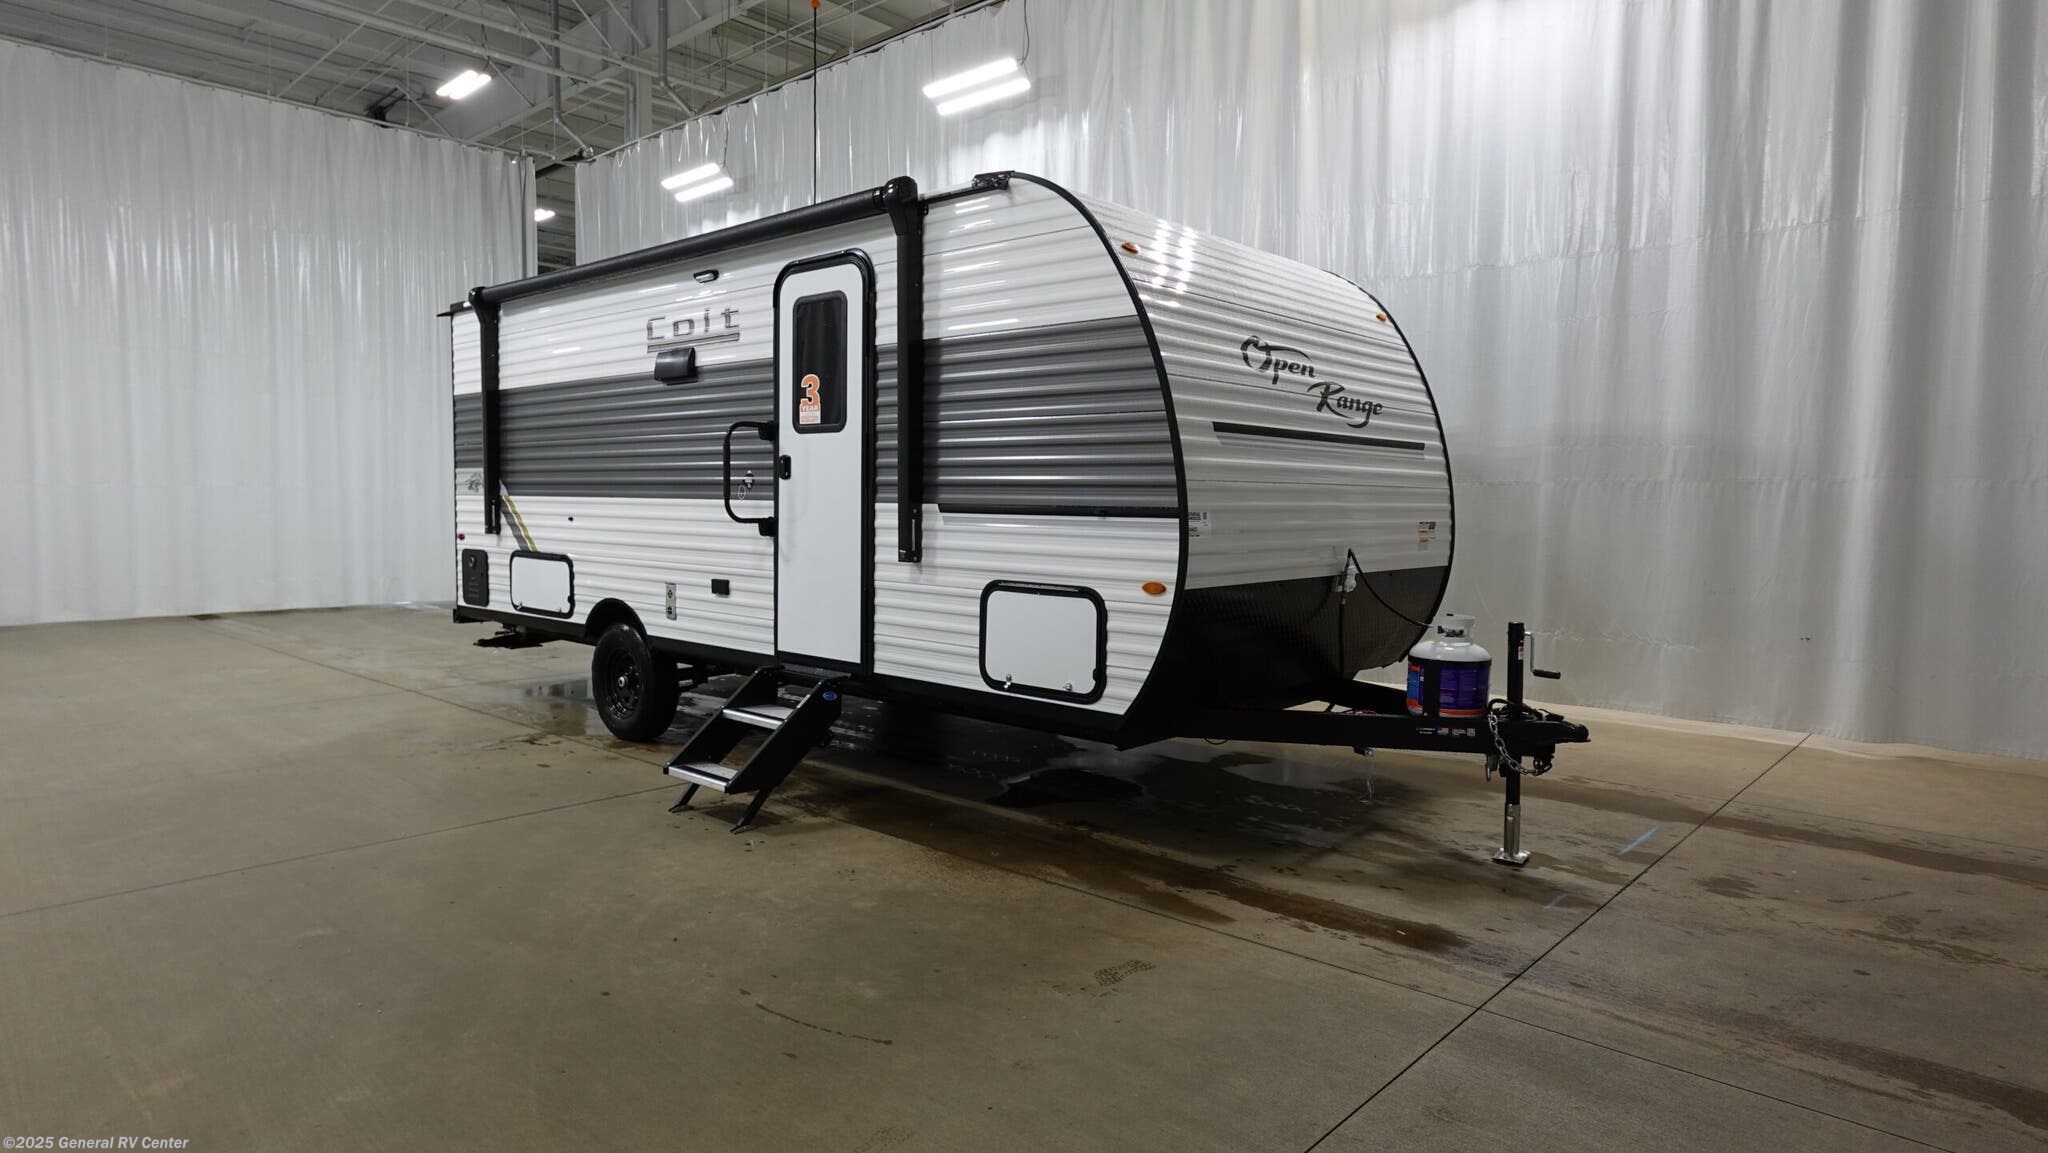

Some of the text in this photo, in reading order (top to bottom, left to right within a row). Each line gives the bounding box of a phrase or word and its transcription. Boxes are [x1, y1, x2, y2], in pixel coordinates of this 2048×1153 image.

[1240, 335, 1316, 385] Open
[801, 374, 820, 406] 3
[1307, 381, 1384, 429] Range
